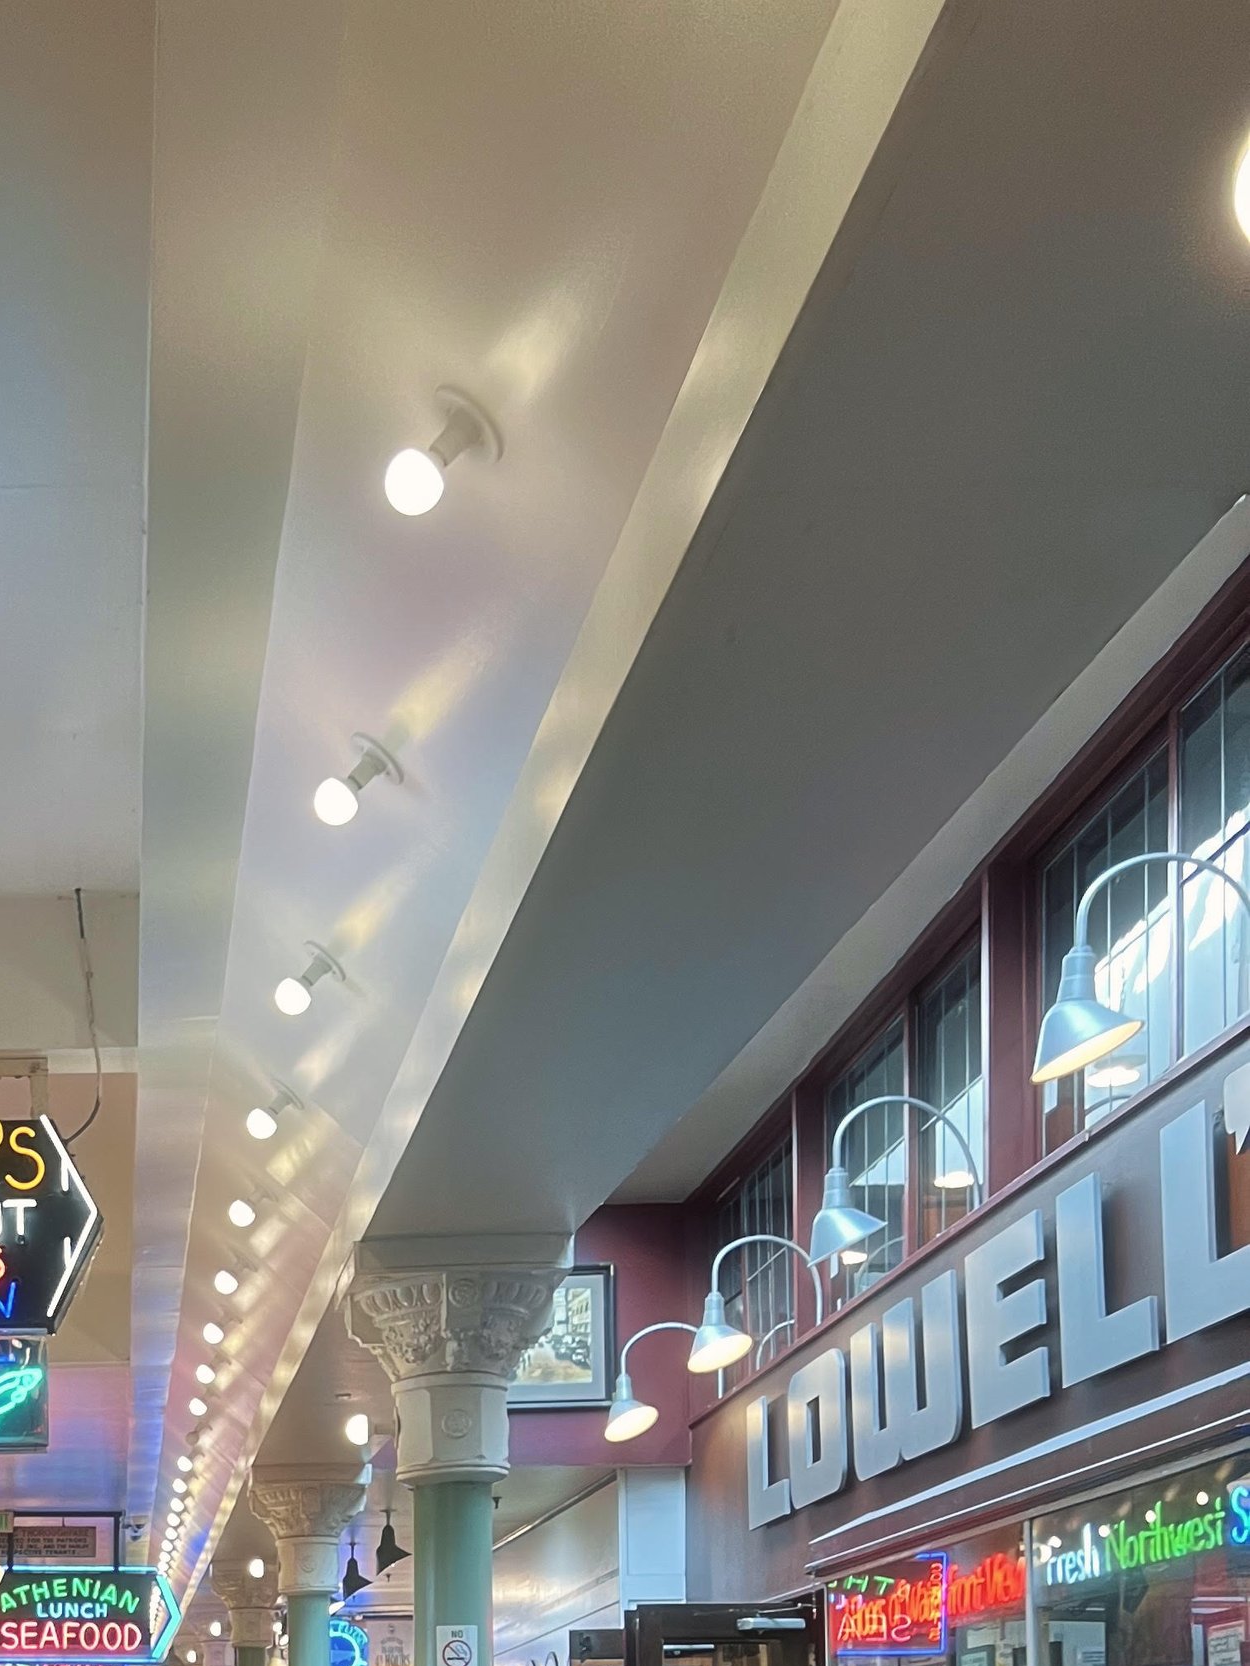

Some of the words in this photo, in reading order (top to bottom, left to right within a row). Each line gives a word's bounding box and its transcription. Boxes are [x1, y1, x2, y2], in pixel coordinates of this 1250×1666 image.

[1104, 1496, 1226, 1572] Northwest
[0, 1576, 141, 1615] ATHENIAN
[36, 1601, 109, 1619] LUNCH
[0, 1620, 143, 1651] SEAFOOD
[451, 1630, 464, 1639] NO
